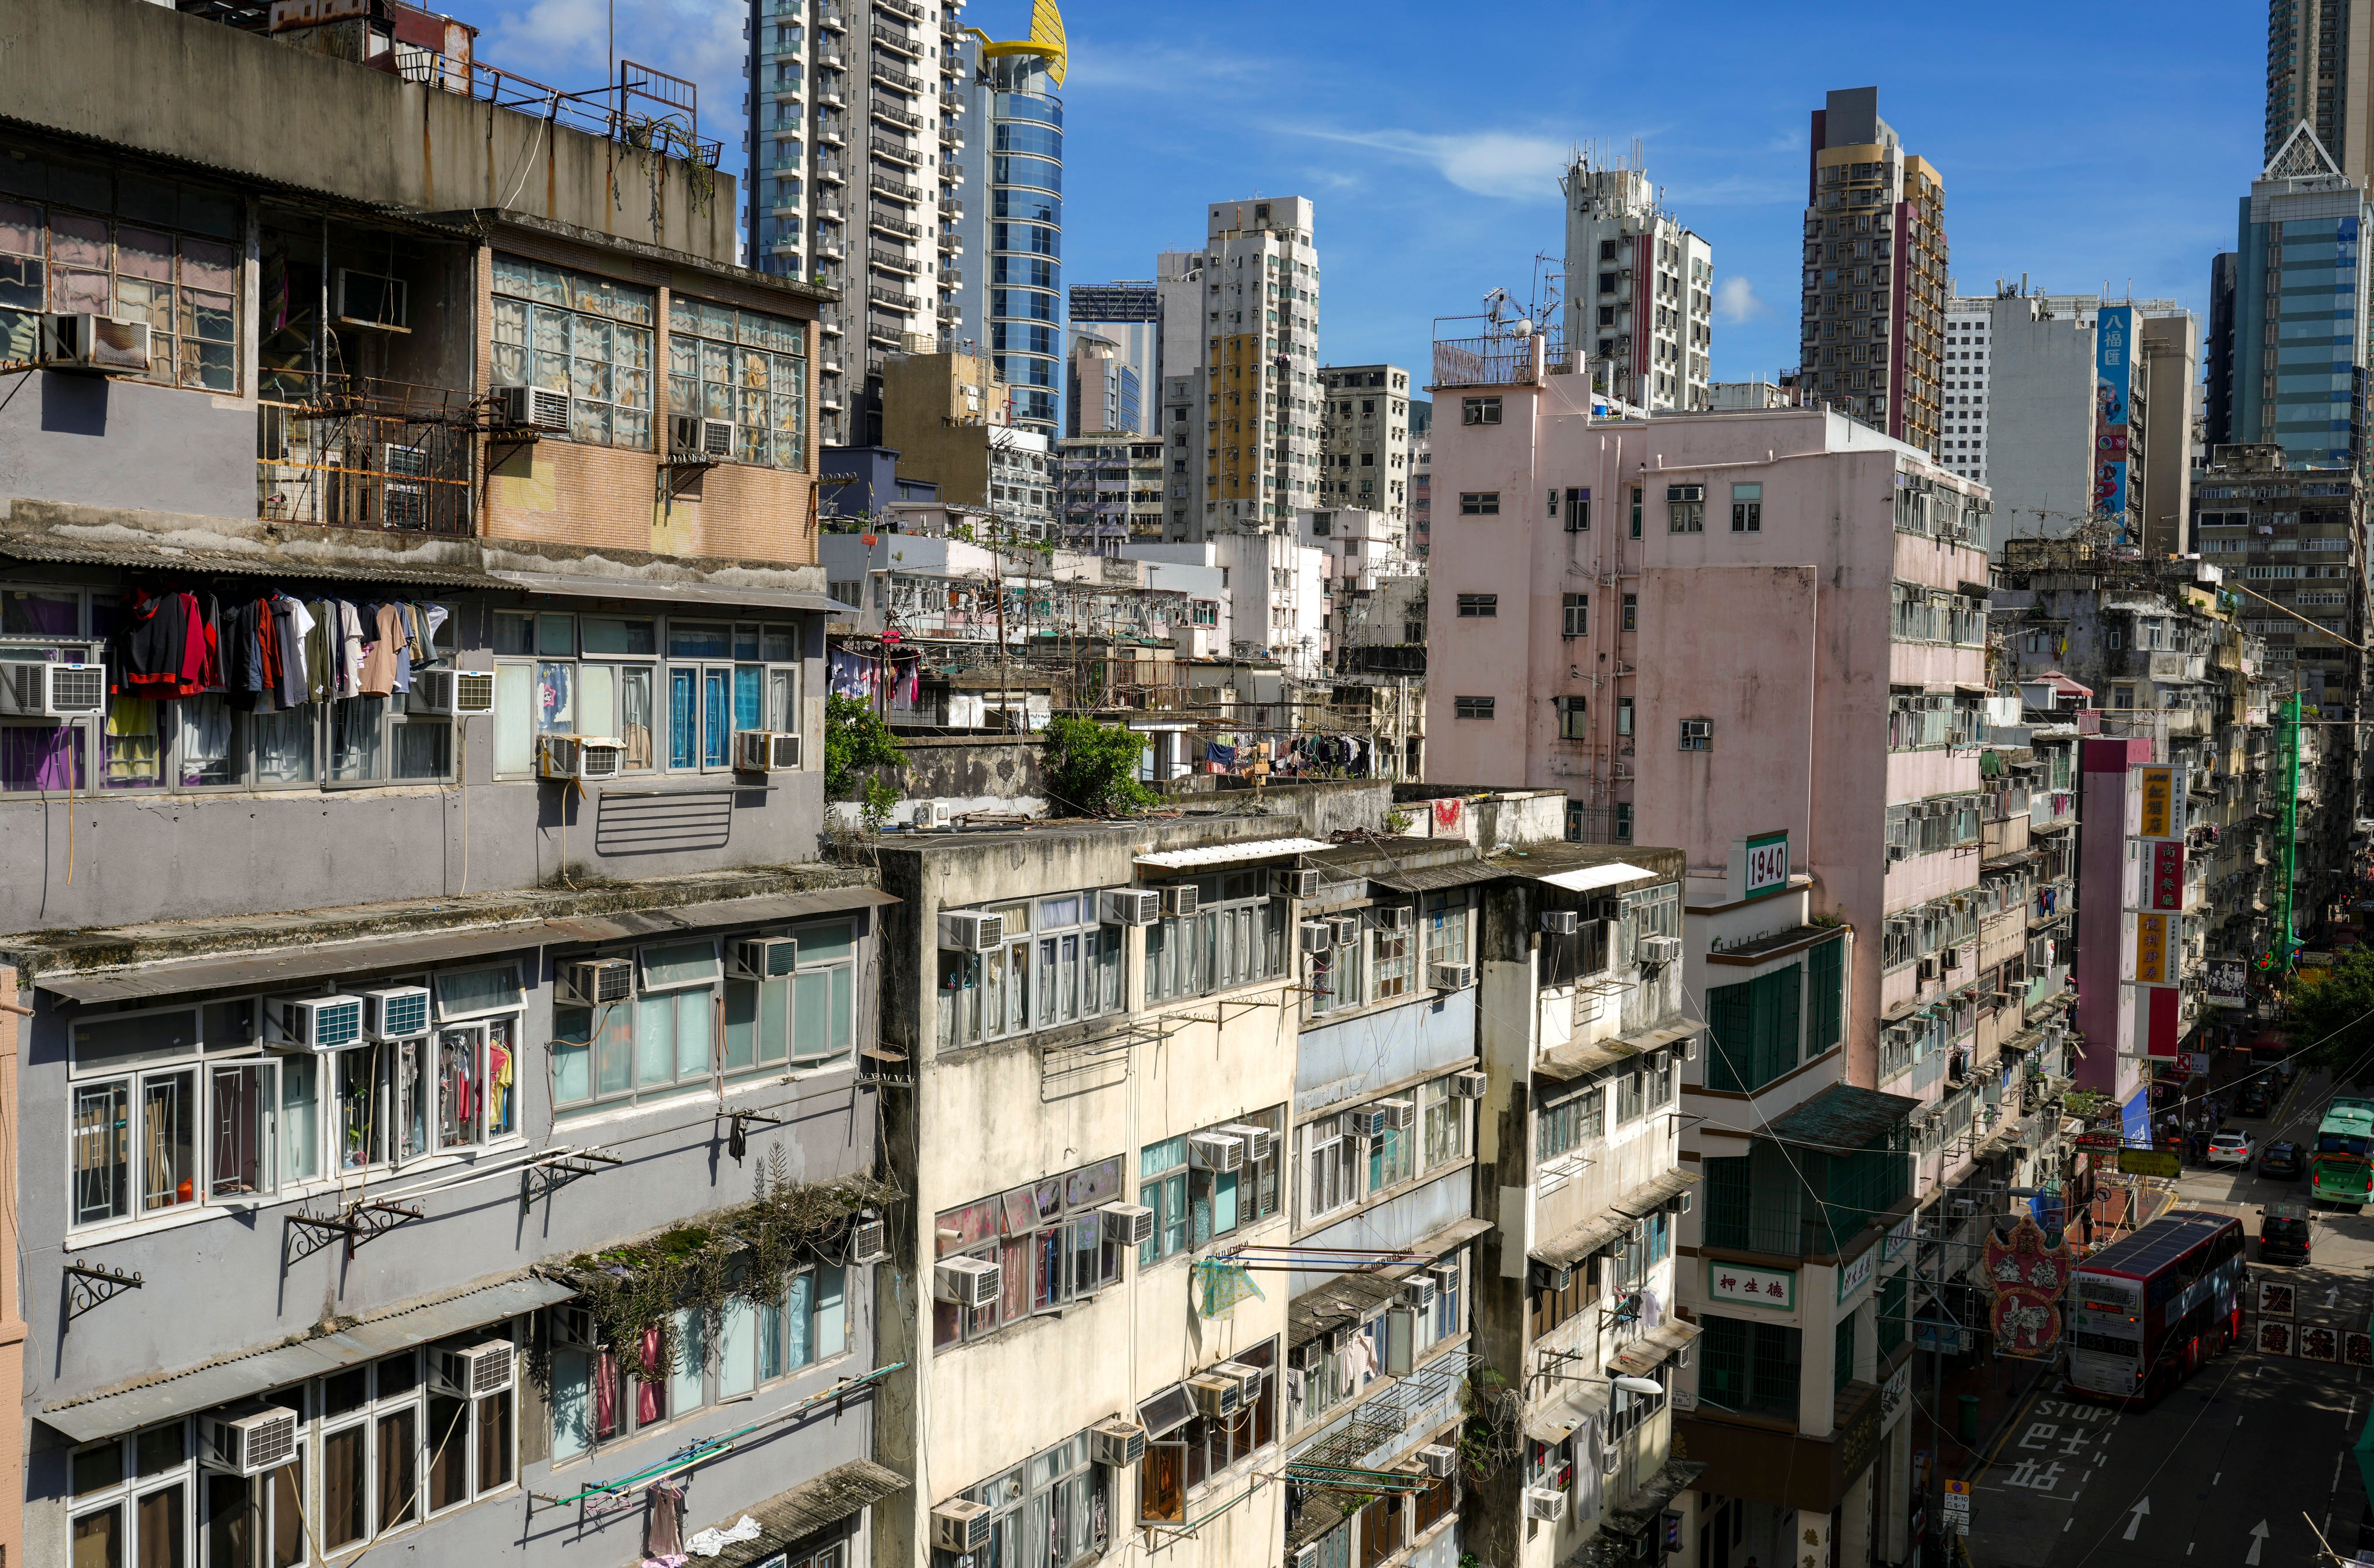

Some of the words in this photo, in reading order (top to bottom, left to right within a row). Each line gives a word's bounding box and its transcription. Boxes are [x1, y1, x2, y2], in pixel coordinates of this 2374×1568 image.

[2103, 315, 2124, 365] 八福匯
[2147, 785, 2165, 833] 紅酒店
[1752, 847, 1783, 885] 1940
[2144, 917, 2158, 979] 便利廚房
[2000, 1295, 2050, 1346] 押
[2111, 1339, 2136, 1355] 183
[2035, 1400, 2113, 1422] STOP
[2018, 1423, 2091, 1455] 巴士
[2001, 1458, 2067, 1491] 站
